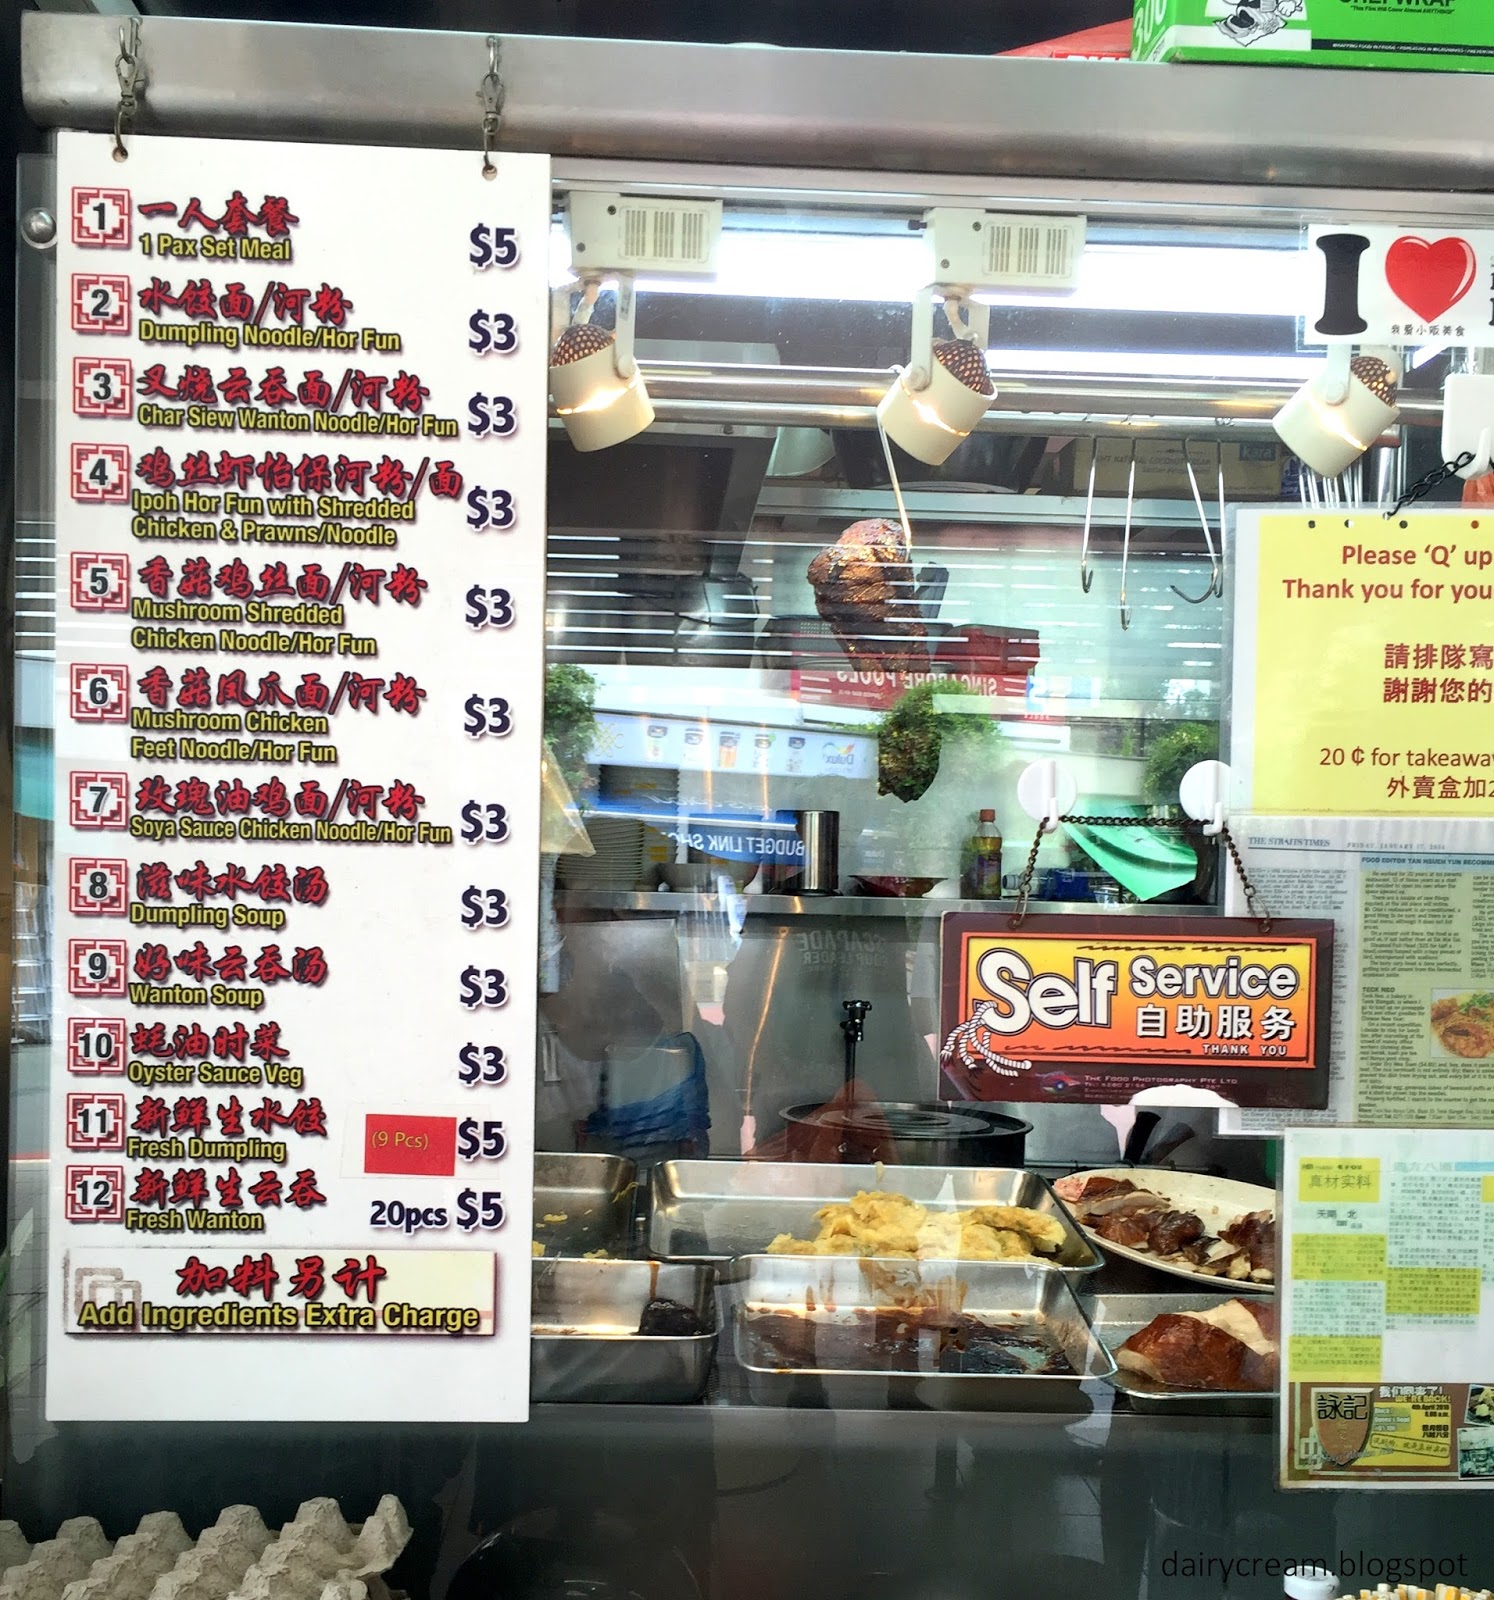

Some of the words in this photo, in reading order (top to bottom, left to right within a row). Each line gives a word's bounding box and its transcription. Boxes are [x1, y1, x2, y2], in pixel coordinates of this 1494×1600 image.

[93, 203, 106, 230] 1
[140, 234, 151, 255] 1
[158, 235, 196, 257] Pax
[202, 237, 236, 258] Set
[241, 237, 290, 260] Meal
[469, 223, 517, 268] $5
[1314, 233, 1371, 336] I
[91, 289, 109, 318] 2
[139, 320, 238, 348] Dumpling
[244, 324, 358, 349] Noodle/Hor
[363, 328, 400, 351] Fun
[468, 309, 516, 354] $3
[93, 372, 111, 400] 3
[139, 405, 183, 427] Char
[188, 407, 235, 429] Siew
[239, 408, 308, 431] Wanton
[314, 411, 418, 435] Noodle/Hor
[423, 415, 458, 437] Fun
[468, 392, 515, 437] $3
[89, 458, 108, 486] 4
[133, 489, 177, 514] Ipoh
[184, 492, 219, 513] Hor
[226, 494, 262, 514] Fun
[268, 494, 312, 517] with
[318, 497, 414, 521] Shredded
[466, 486, 514, 530] $3
[133, 517, 215, 541] Chicken
[221, 521, 236, 541] &
[242, 521, 397, 546] Prawns/Noodle
[1342, 545, 1416, 565] Please
[1464, 550, 1493, 570] up
[90, 568, 108, 597] 5
[1283, 578, 1354, 599] Thank
[1361, 584, 1402, 603] you
[1411, 578, 1444, 599] for
[133, 599, 241, 622] Mushroom
[246, 602, 343, 625] Shredded
[465, 585, 513, 629] $3
[133, 629, 215, 651] Chicken
[221, 630, 334, 655] Noodle/Hor
[339, 634, 376, 656] Fun
[1384, 643, 1494, 670] 請排隊寫
[89, 676, 108, 706] 6
[1383, 677, 1492, 703] 謝謝您的
[132, 709, 241, 731] Mushroom
[246, 711, 328, 733] Chicken
[463, 694, 512, 738] $3
[132, 738, 175, 761] Feet
[180, 739, 294, 763] Noodle/Hor
[299, 742, 337, 763] Fun
[1319, 748, 1345, 766] 20
[1371, 748, 1401, 766] for
[1406, 748, 1494, 767] takeawa
[89, 786, 107, 814] 7
[131, 817, 175, 843] Soya
[180, 819, 235, 840] Sauce
[239, 819, 310, 841] Chicken
[316, 821, 414, 843] Noodle/Hor
[419, 823, 452, 845] Fun
[460, 800, 509, 845] $3
[1248, 837, 1267, 845] THE
[1268, 838, 1304, 846] STRAITS
[1304, 839, 1330, 847] TIMES
[88, 871, 108, 899] 8
[130, 903, 228, 927] Dumpling
[233, 905, 285, 928] Soup
[460, 885, 508, 929] $3
[88, 952, 108, 982] 9
[129, 985, 206, 1005] Wanton
[211, 985, 263, 1008] Soup
[460, 965, 507, 1009] $3
[973, 947, 1118, 1036] Self
[1130, 955, 1299, 999] Service
[1136, 1004, 1295, 1040] 自助服务
[79, 1031, 113, 1060] 10
[1203, 1044, 1248, 1055] THANK
[1261, 1045, 1287, 1056] YOU
[128, 1062, 194, 1084] Oyster
[199, 1064, 259, 1084] Sauce
[265, 1065, 303, 1087] Veg
[458, 1043, 506, 1086] $3
[77, 1108, 109, 1136] 11
[127, 1138, 185, 1159] Fresh
[189, 1139, 286, 1163] Dumpling
[371, 1132, 388, 1149] (9
[395, 1132, 429, 1151] Pcs)
[458, 1118, 505, 1162] $5
[77, 1180, 110, 1208] 12
[125, 1209, 182, 1230] Fresh
[187, 1210, 263, 1231] Wanton
[370, 1200, 447, 1234] 20pcs
[457, 1188, 504, 1233] $5
[176, 1254, 387, 1302] 加料另计
[78, 1303, 133, 1326] Add
[143, 1302, 296, 1330] Ingredients
[305, 1304, 373, 1327] Extra
[378, 1304, 479, 1332] Charge
[1317, 1394, 1368, 1420] 詠記
